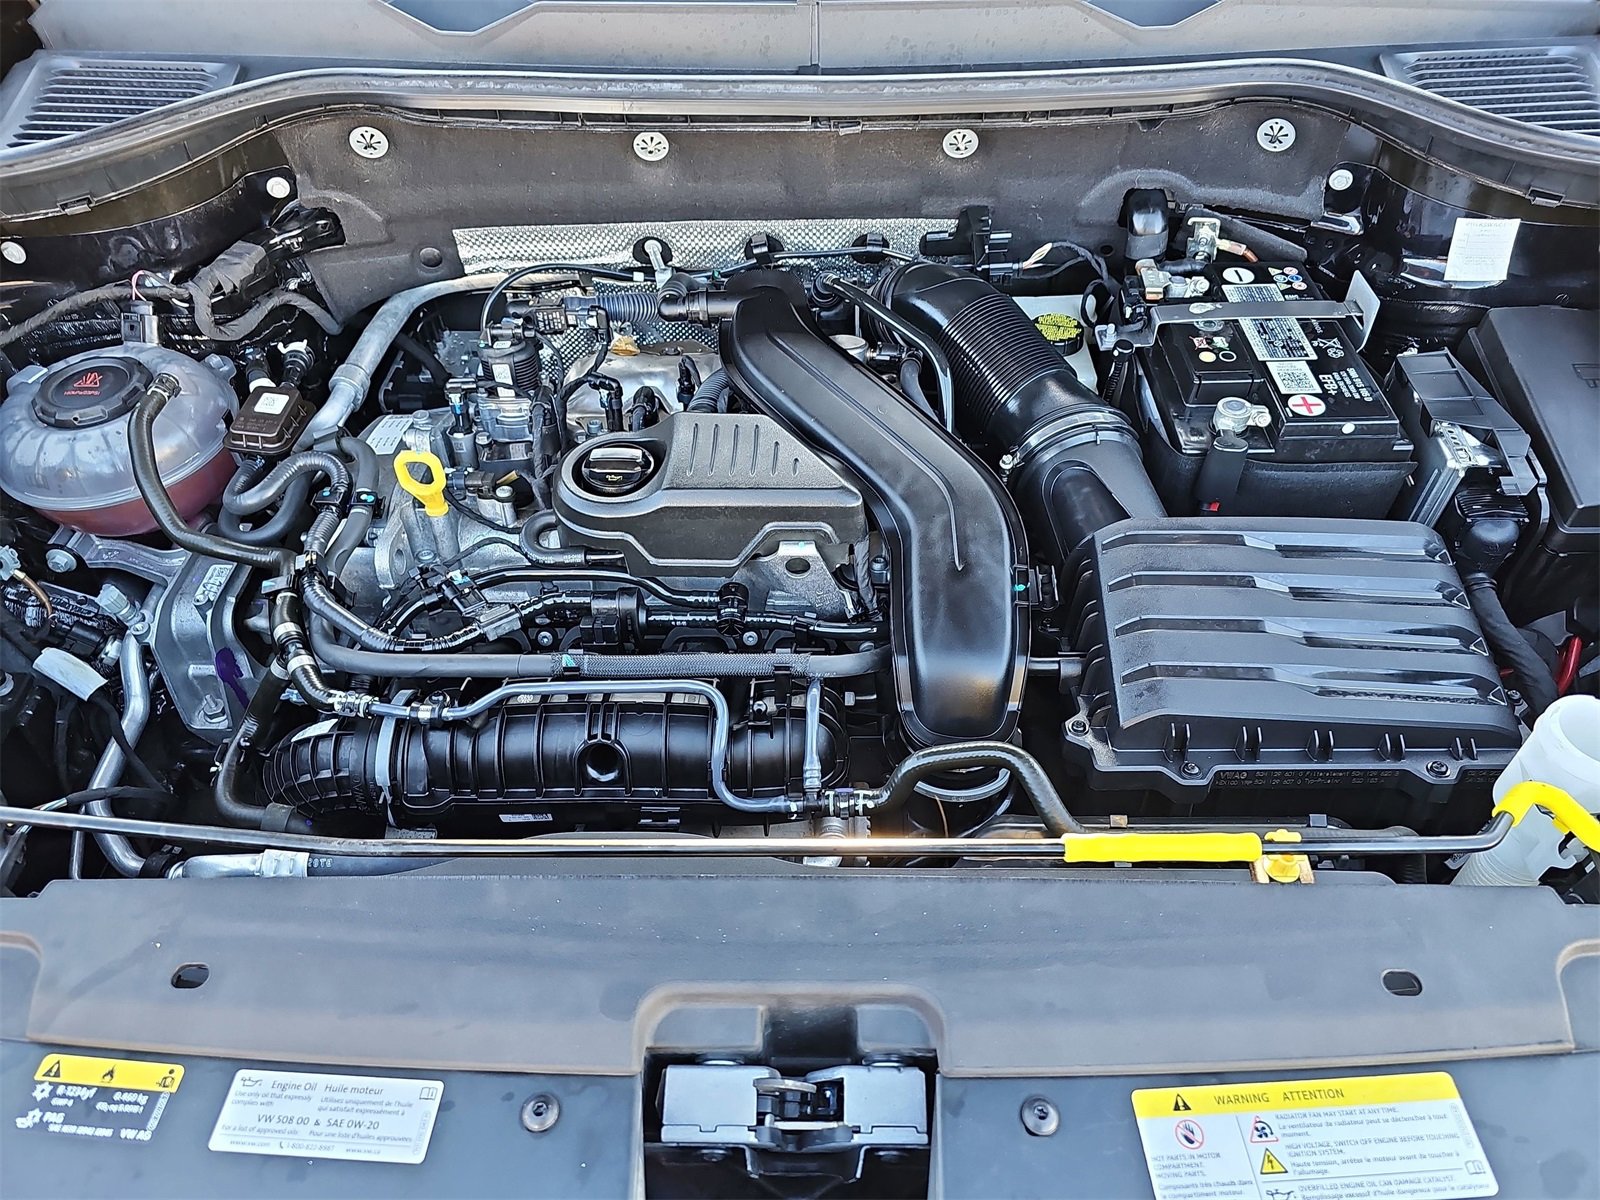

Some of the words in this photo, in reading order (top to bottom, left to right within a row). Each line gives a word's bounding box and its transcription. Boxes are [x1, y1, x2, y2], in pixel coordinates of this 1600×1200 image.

[1318, 374, 1338, 396] EFB+
[272, 1080, 300, 1092] Engine
[304, 1082, 318, 1091] Oil
[324, 1084, 348, 1094] Huile
[350, 1087, 384, 1096] moteur
[1214, 1092, 1270, 1105] WARNING
[1283, 1088, 1345, 1102] ATTENTION
[258, 1114, 276, 1124] VW
[276, 1115, 294, 1124] 508
[296, 1116, 310, 1126] 00
[326, 1118, 344, 1128] SAE
[346, 1120, 380, 1130] 0W-20
